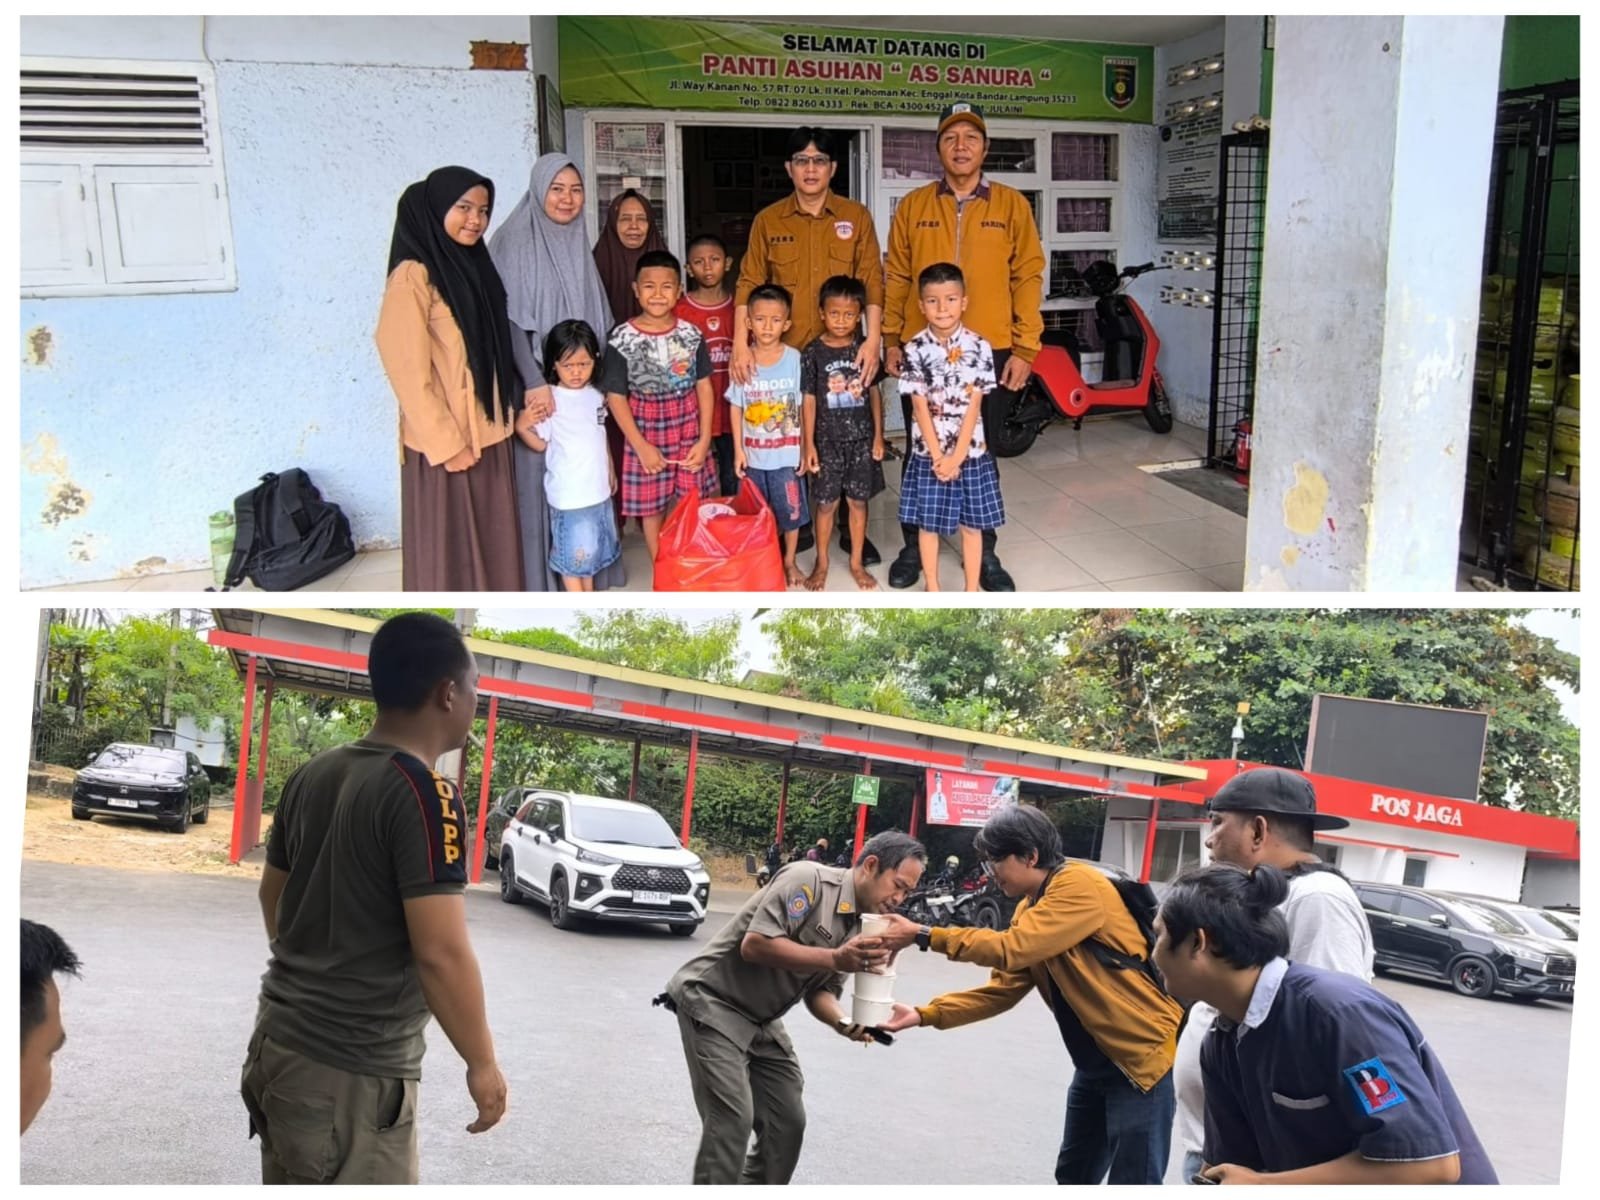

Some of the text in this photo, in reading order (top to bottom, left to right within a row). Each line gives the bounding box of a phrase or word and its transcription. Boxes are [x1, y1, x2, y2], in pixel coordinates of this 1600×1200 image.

[783, 34, 985, 59] SELAMAT DATANG DI
[703, 55, 776, 76] PANTI
[785, 59, 882, 81] ASUHAN
[909, 65, 939, 83] AS
[946, 66, 1033, 87] SANURA
[669, 80, 680, 90] Jl.
[683, 81, 704, 92] Way
[707, 82, 740, 91] Kanan
[743, 83, 759, 92] No.
[763, 84, 774, 92] 57
[794, 86, 806, 94] 07
[809, 86, 822, 95] Lk.
[834, 87, 851, 95] Kel.
[854, 88, 898, 97] Pahoman
[901, 89, 919, 98] Kec.
[922, 90, 952, 100] Enggal
[955, 91, 974, 100] Kota
[977, 92, 1007, 100] Bandar
[1010, 94, 1050, 104] Lampung
[739, 96, 761, 108] Telp.
[765, 98, 789, 107] 0822
[792, 99, 817, 108] 8260
[819, 100, 842, 109] 4333
[851, 101, 870, 109] Rek.
[873, 101, 893, 109] BCA
[900, 102, 923, 110] 4300
[990, 105, 1023, 113] JULAINI
[770, 235, 794, 243] PERS
[825, 360, 862, 373] GEMO
[1370, 793, 1463, 827] POS JAGA
